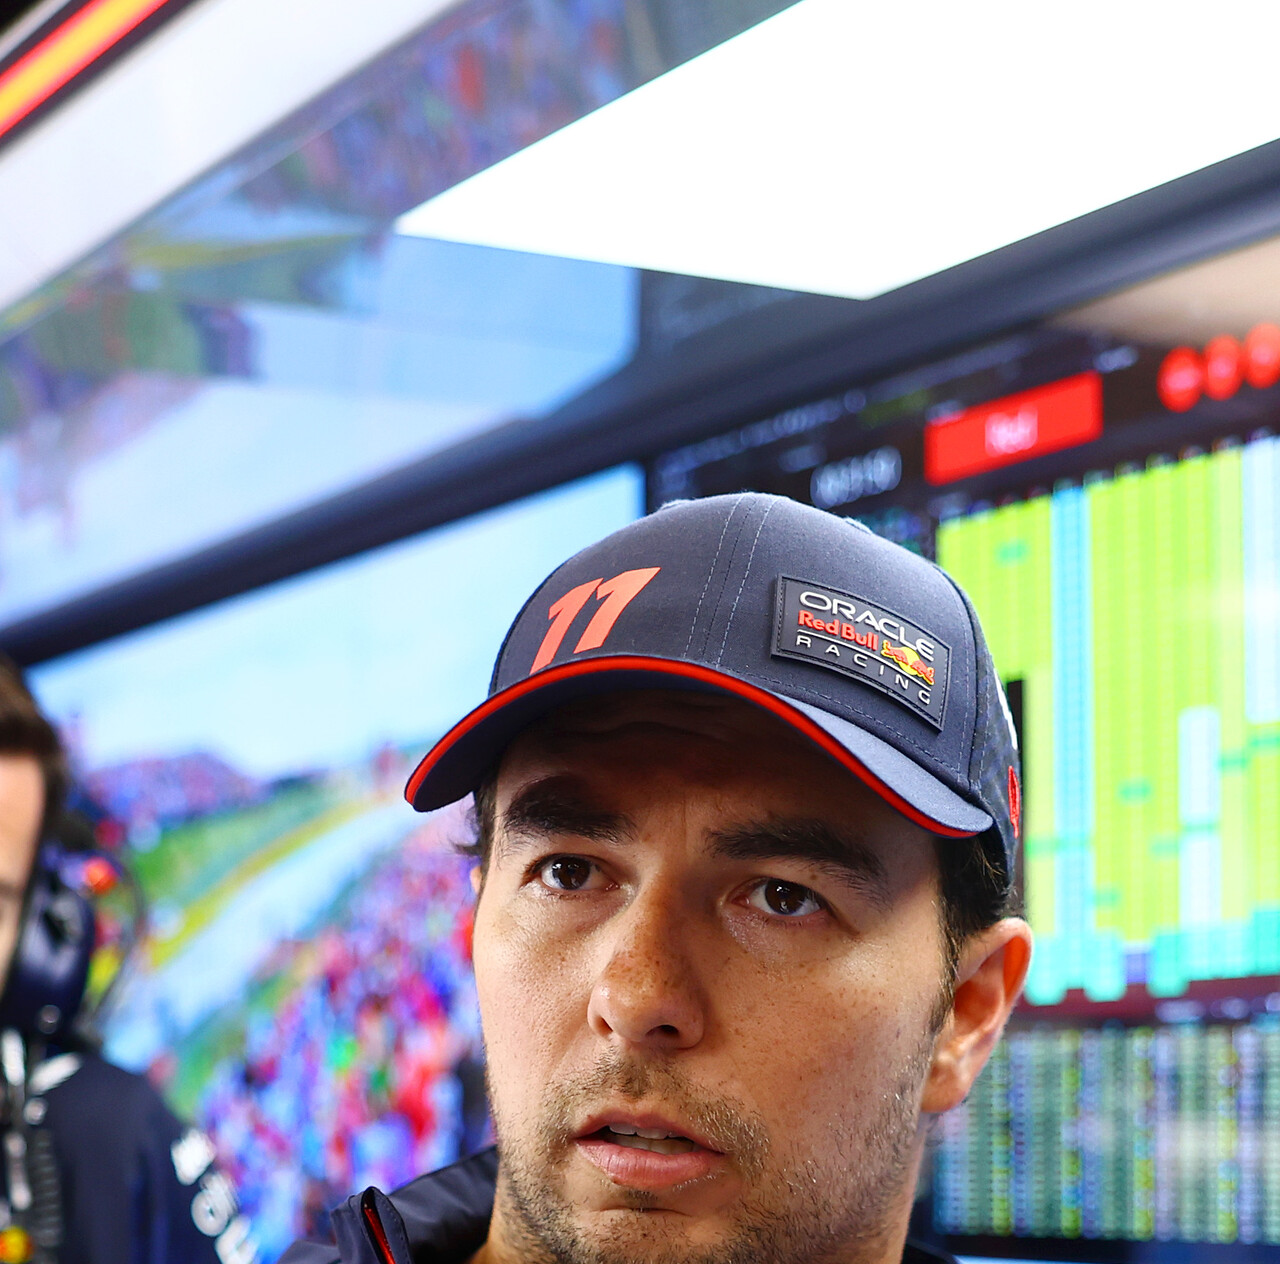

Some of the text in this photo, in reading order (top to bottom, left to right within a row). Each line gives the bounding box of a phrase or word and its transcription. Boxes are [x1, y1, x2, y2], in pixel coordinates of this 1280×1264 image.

[530, 566, 660, 675] 11
[797, 609, 880, 651] Red Bull
[799, 591, 935, 662] ORACLE
[795, 635, 932, 705] RACING
